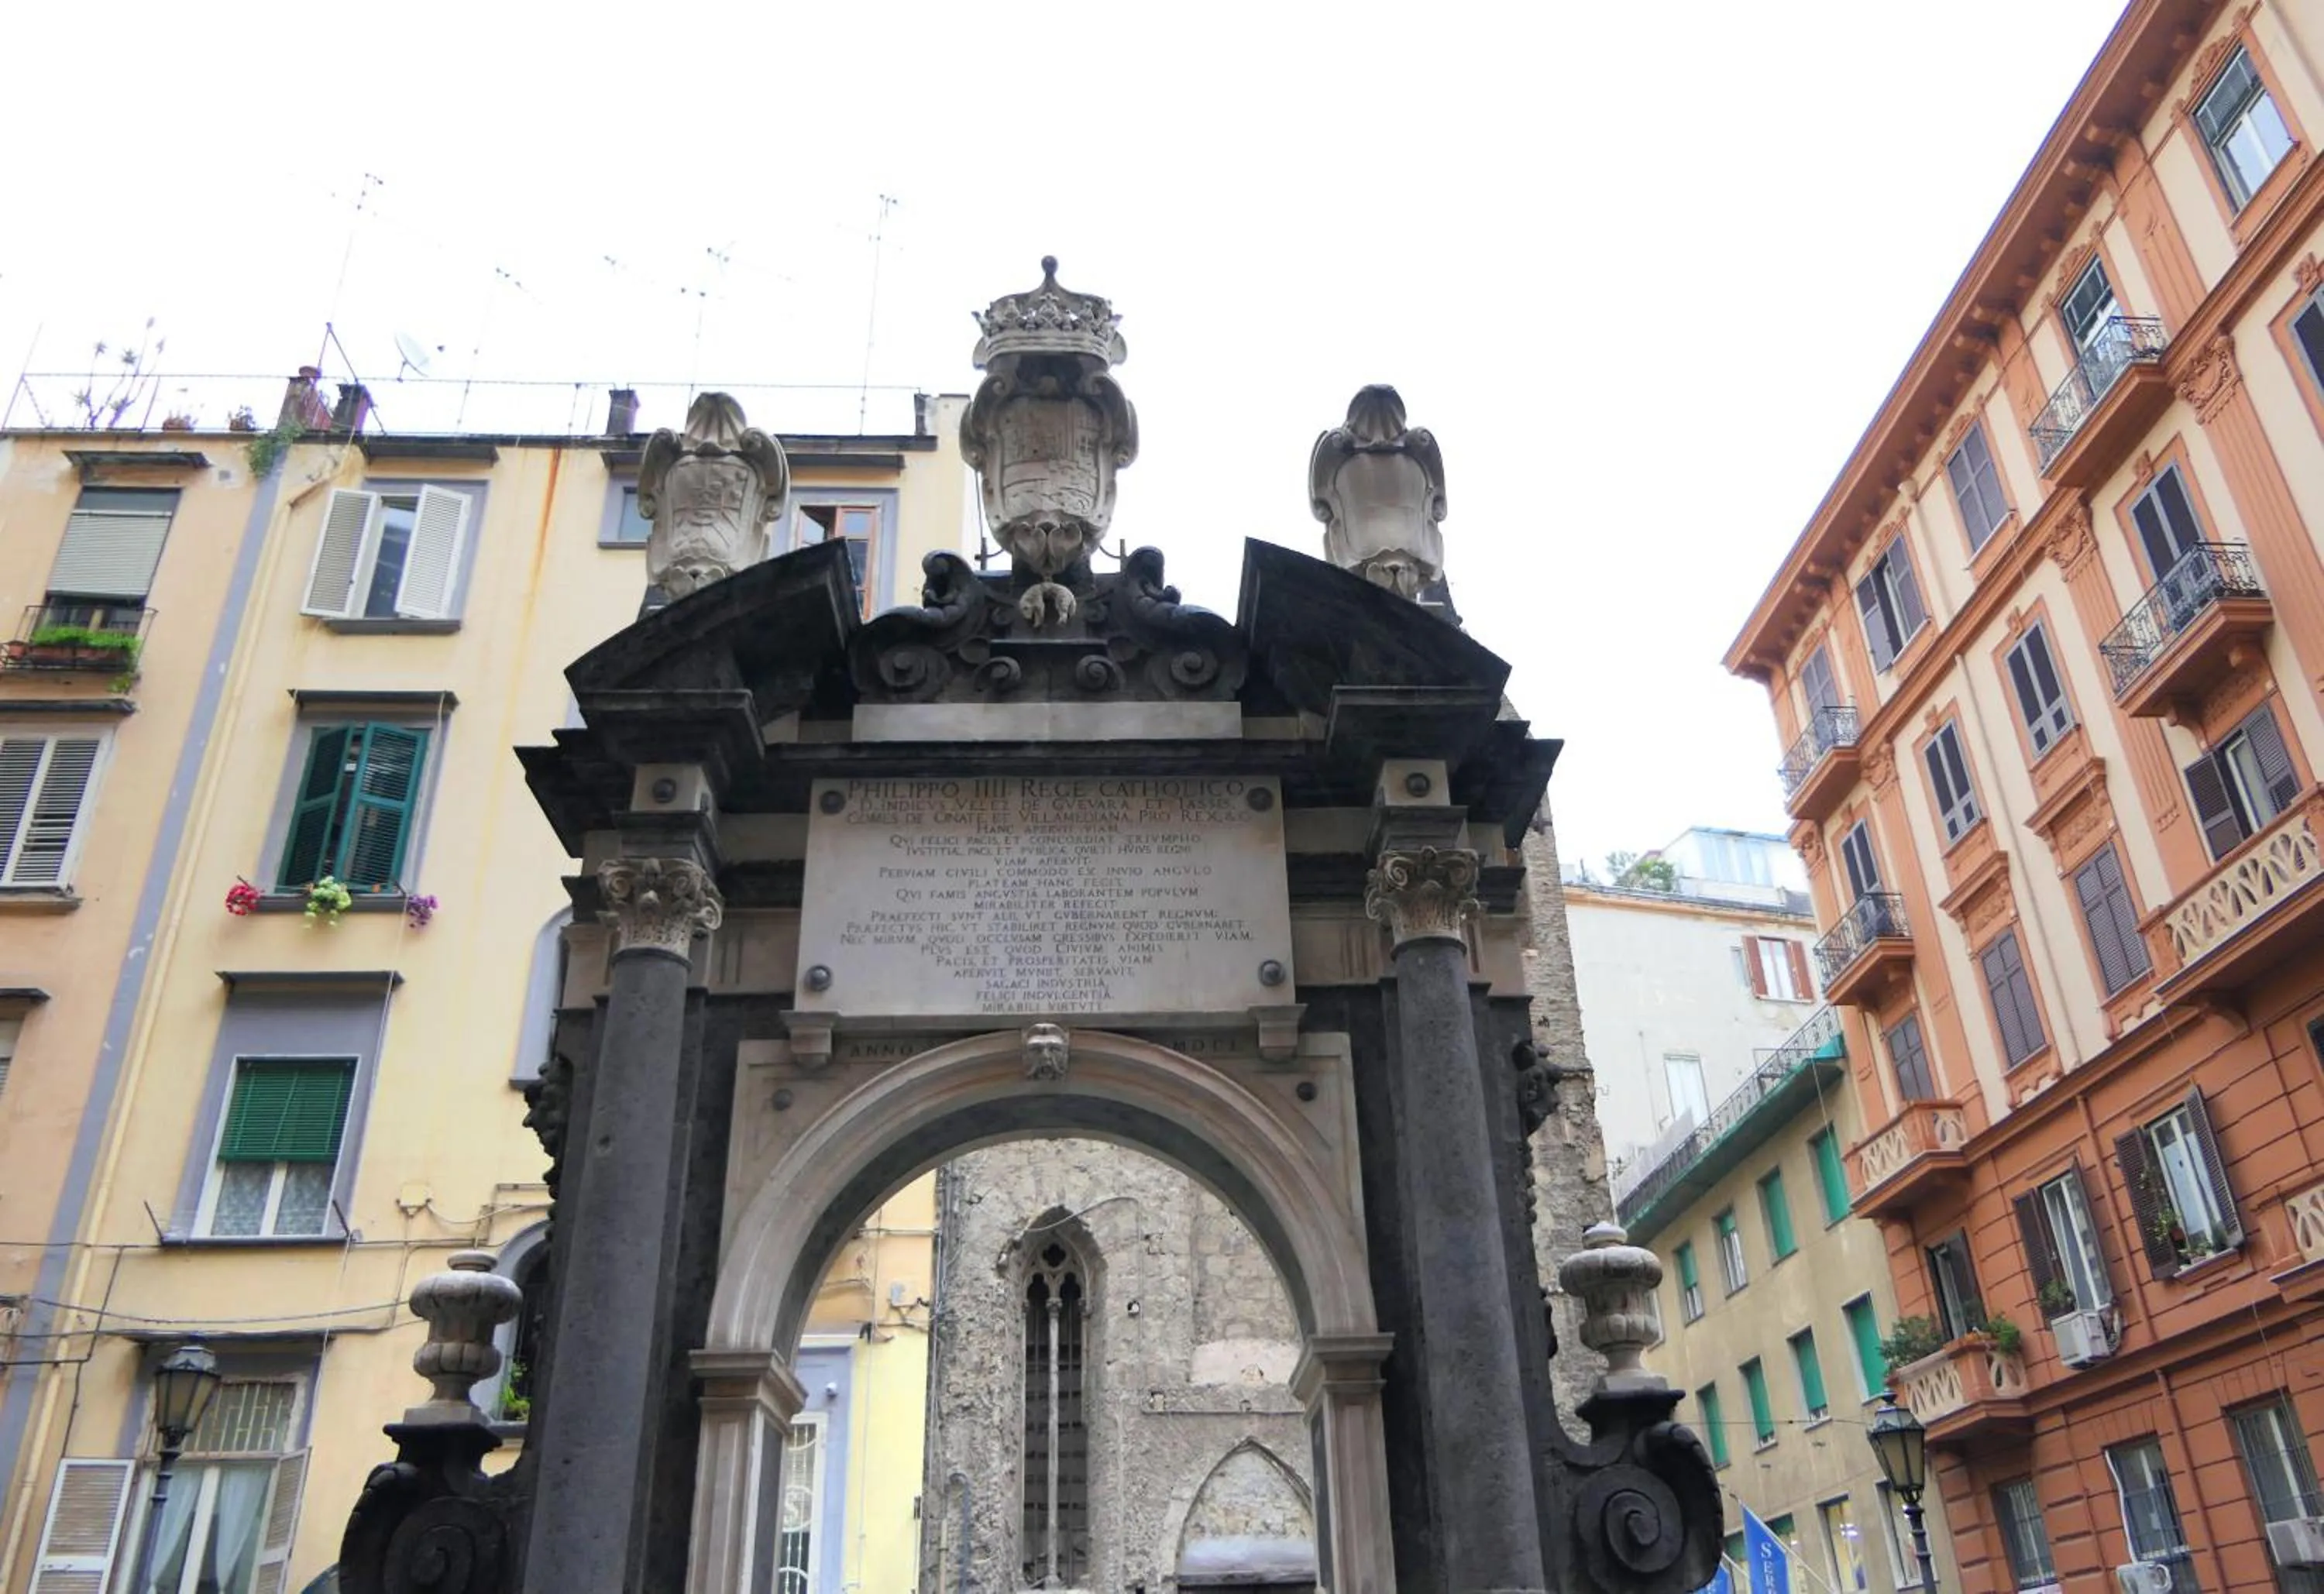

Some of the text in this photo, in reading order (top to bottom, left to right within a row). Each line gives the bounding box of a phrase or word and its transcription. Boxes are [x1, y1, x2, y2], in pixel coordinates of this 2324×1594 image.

[848, 778, 1244, 799] PHILIPPO IIII REGE CATHOLICO
[993, 857, 1027, 867] VIAM
[995, 866, 1068, 878] COMMODO
[896, 888, 922, 903] QVI
[1760, 1541, 1777, 1593] SER
